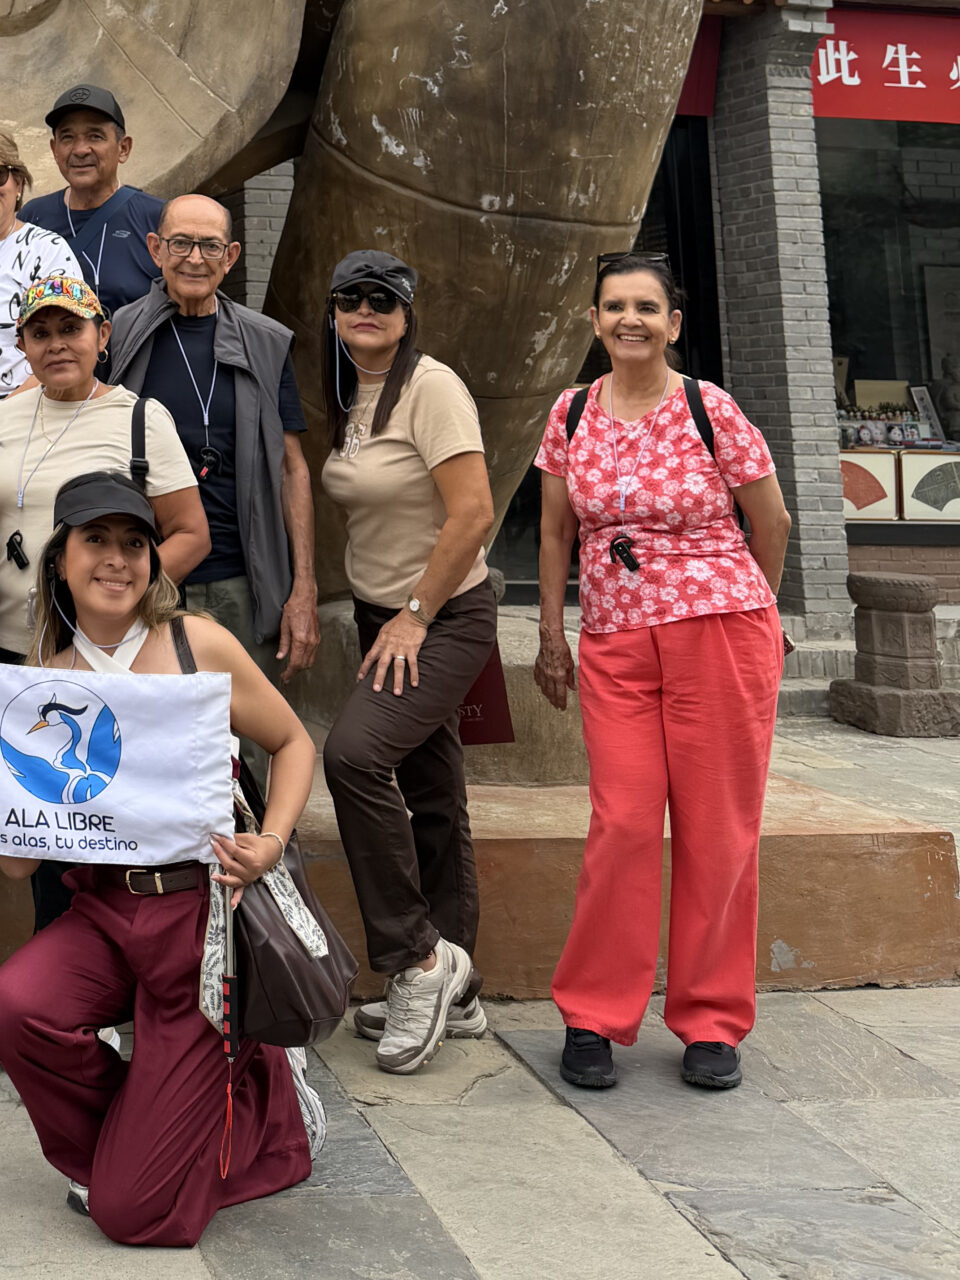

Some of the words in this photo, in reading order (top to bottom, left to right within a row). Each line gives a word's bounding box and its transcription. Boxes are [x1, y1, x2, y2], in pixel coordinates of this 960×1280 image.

[817, 39, 959, 91] 此生
[26, 278, 84, 306] POLSKA
[5, 808, 50, 828] ALA
[55, 811, 116, 833] LIBRE
[12, 833, 50, 851] alas,
[55, 834, 74, 849] tu
[78, 835, 138, 851] destino
